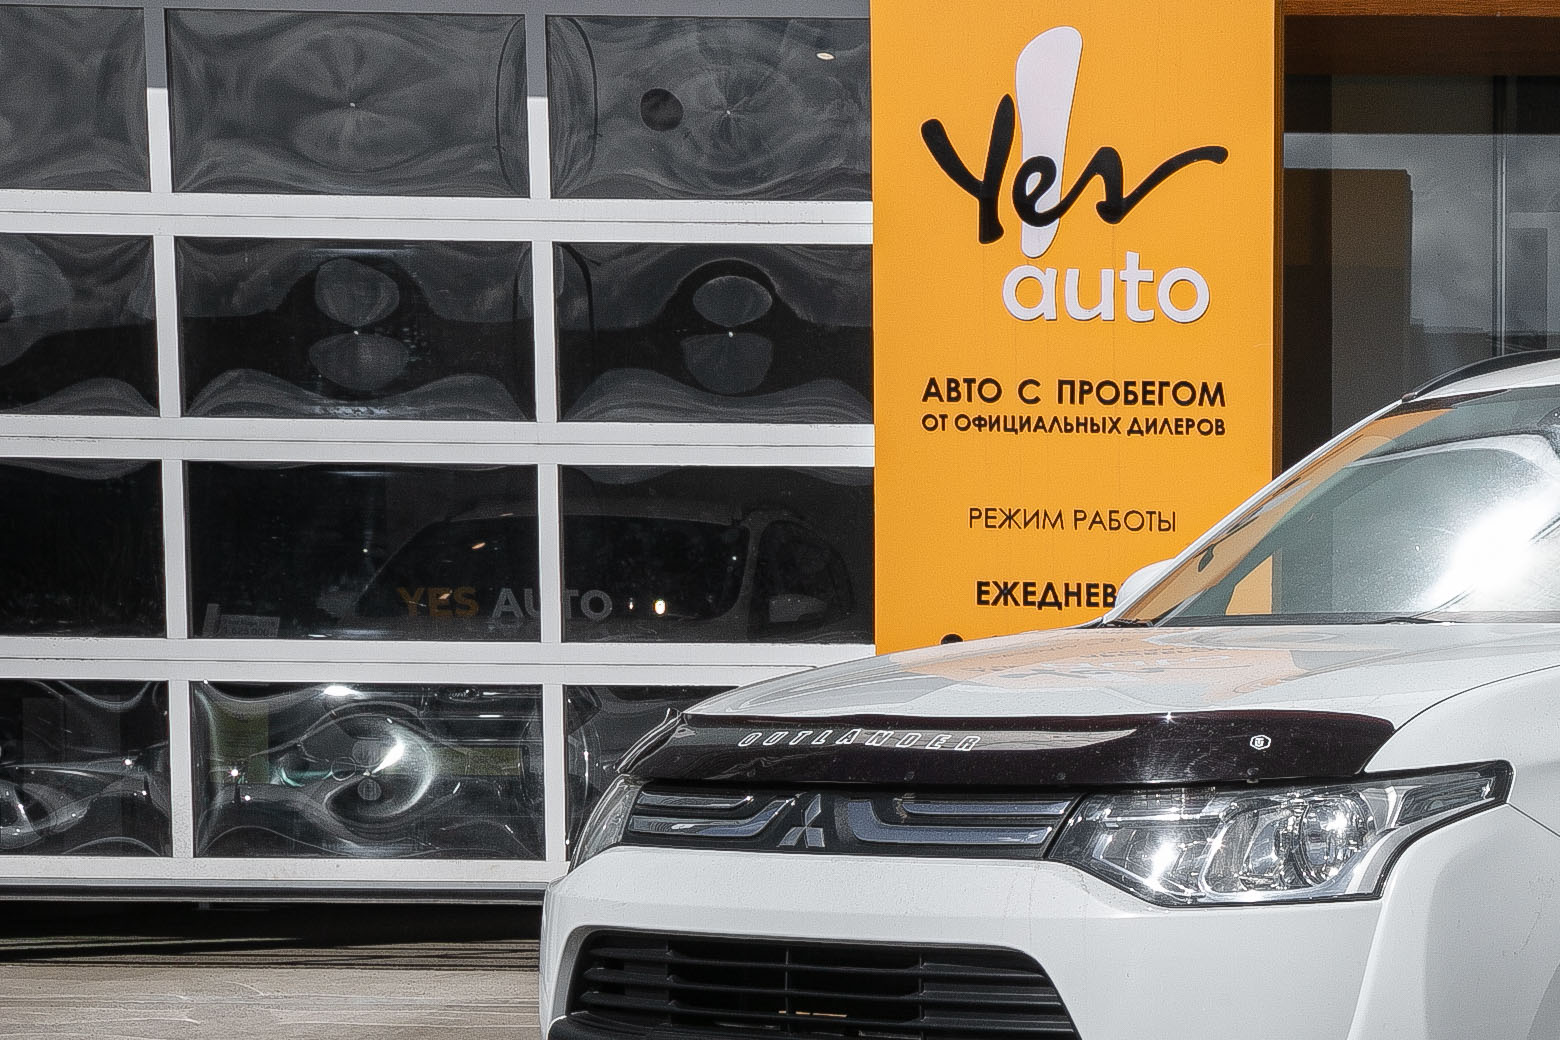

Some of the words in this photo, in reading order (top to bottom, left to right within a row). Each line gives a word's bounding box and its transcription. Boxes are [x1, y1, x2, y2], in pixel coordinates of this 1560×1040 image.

[1002, 251, 1210, 323] auto
[921, 377, 1002, 403] АВТО
[1018, 378, 1041, 405] С
[1057, 378, 1226, 407] ПРОБЕГОМ
[921, 413, 948, 432] ОТ
[954, 413, 1122, 435] ОФИЦИАЛЬНЫХ
[1126, 416, 1226, 437] ДИЛЕРОВ
[969, 507, 1064, 531] РЕЖИМ
[1073, 509, 1176, 532] РАБОТЫ
[396, 586, 479, 618] YES
[976, 580, 1120, 610] ЕЖЕДНЕВ
[738, 728, 980, 751] OUTLANDER
